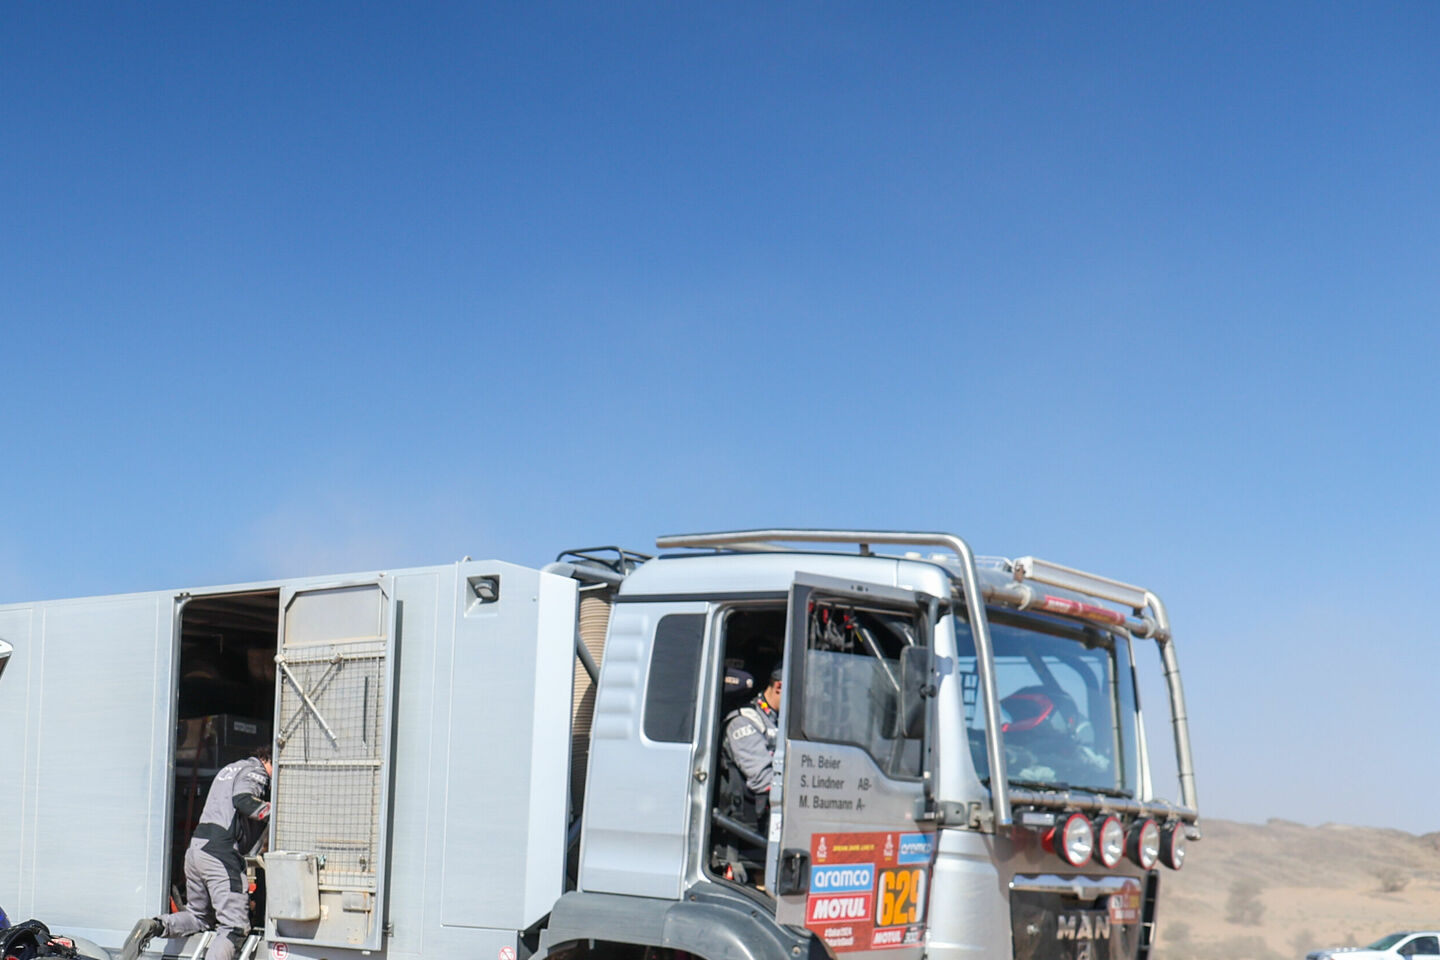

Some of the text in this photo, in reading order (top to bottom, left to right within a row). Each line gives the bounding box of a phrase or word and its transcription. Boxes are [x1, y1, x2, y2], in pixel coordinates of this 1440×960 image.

[801, 754, 841, 769] Ph. Beier
[800, 774, 809, 788] S.
[812, 775, 845, 789] Lindner
[799, 795, 810, 808] M.
[813, 795, 853, 810] Baumann
[814, 869, 870, 888] aramco
[881, 869, 920, 926] 629
[812, 897, 866, 919] MOTUL
[1056, 911, 1110, 940] MAN
